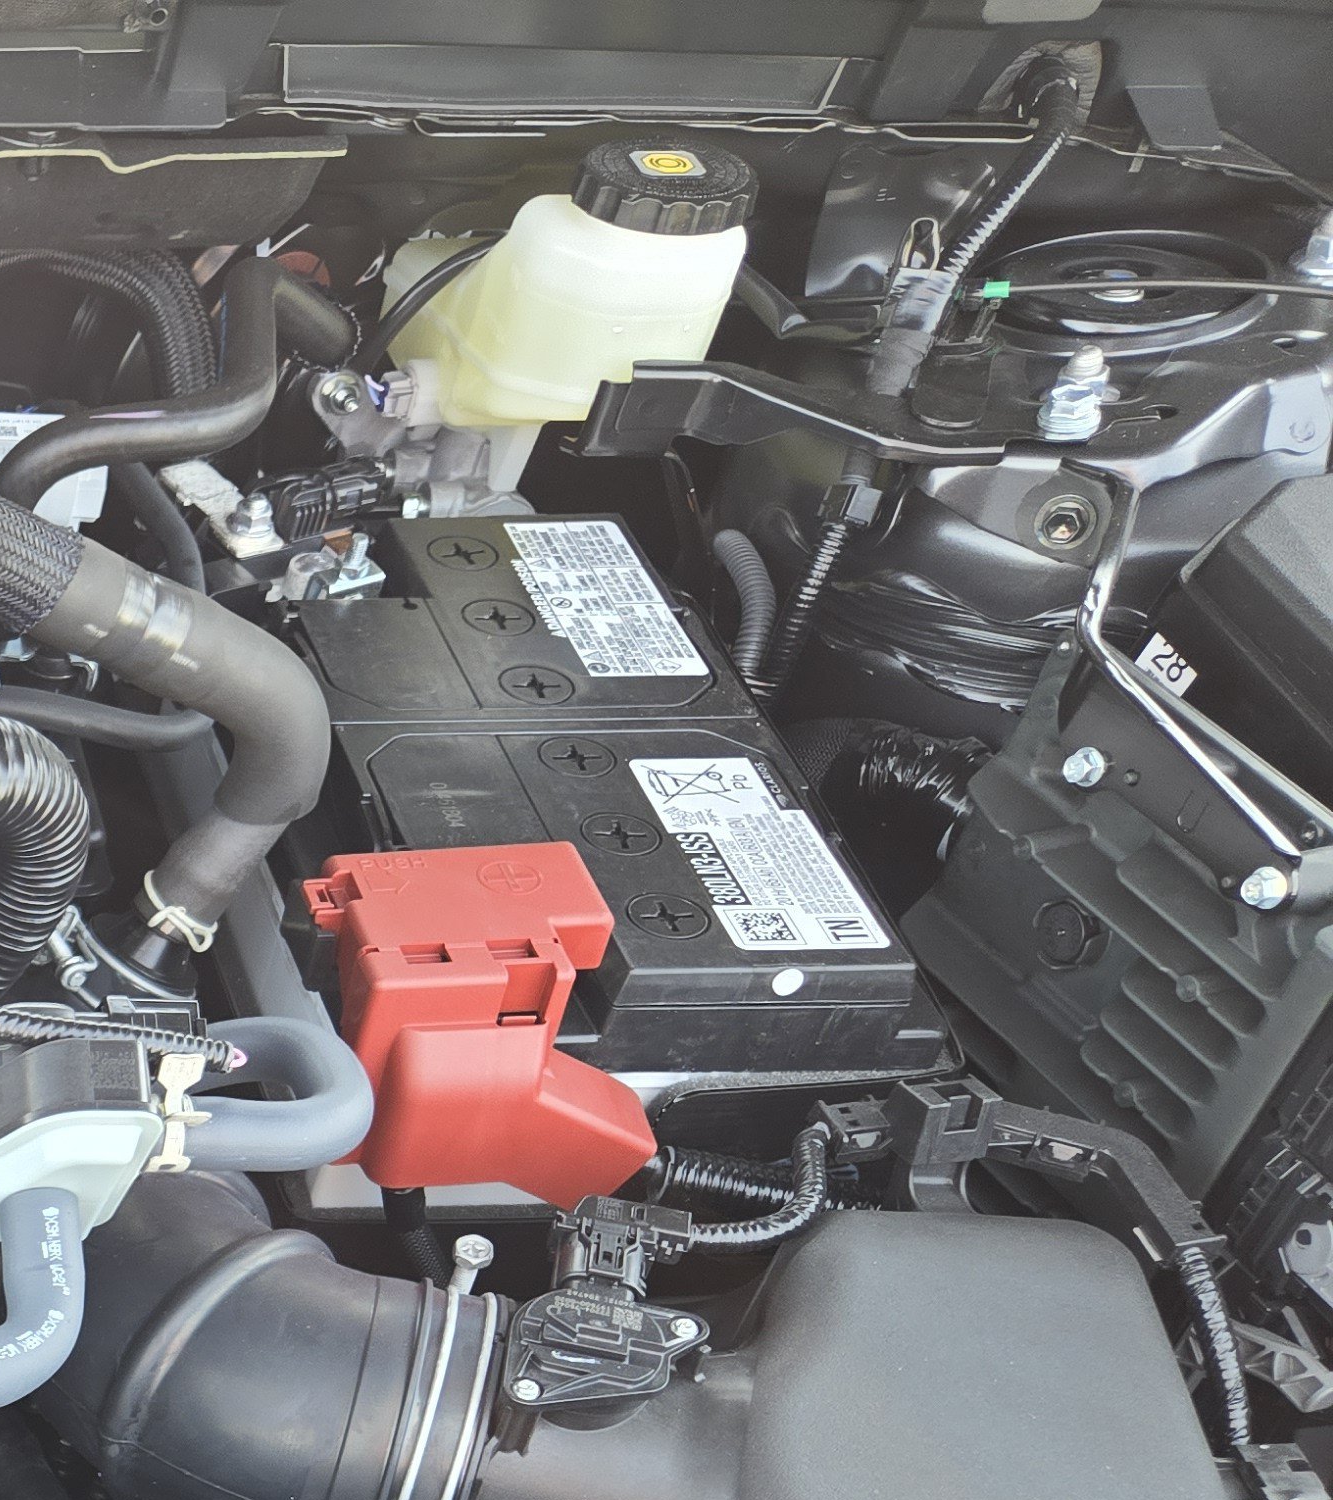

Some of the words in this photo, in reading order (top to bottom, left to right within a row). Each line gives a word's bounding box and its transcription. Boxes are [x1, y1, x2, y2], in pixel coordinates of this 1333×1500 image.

[730, 774, 754, 791] Pb
[754, 761, 782, 794] CLARIOS
[359, 856, 428, 871] PUSH
[675, 833, 747, 905] 380LN3-ISS
[823, 920, 869, 941] TN
